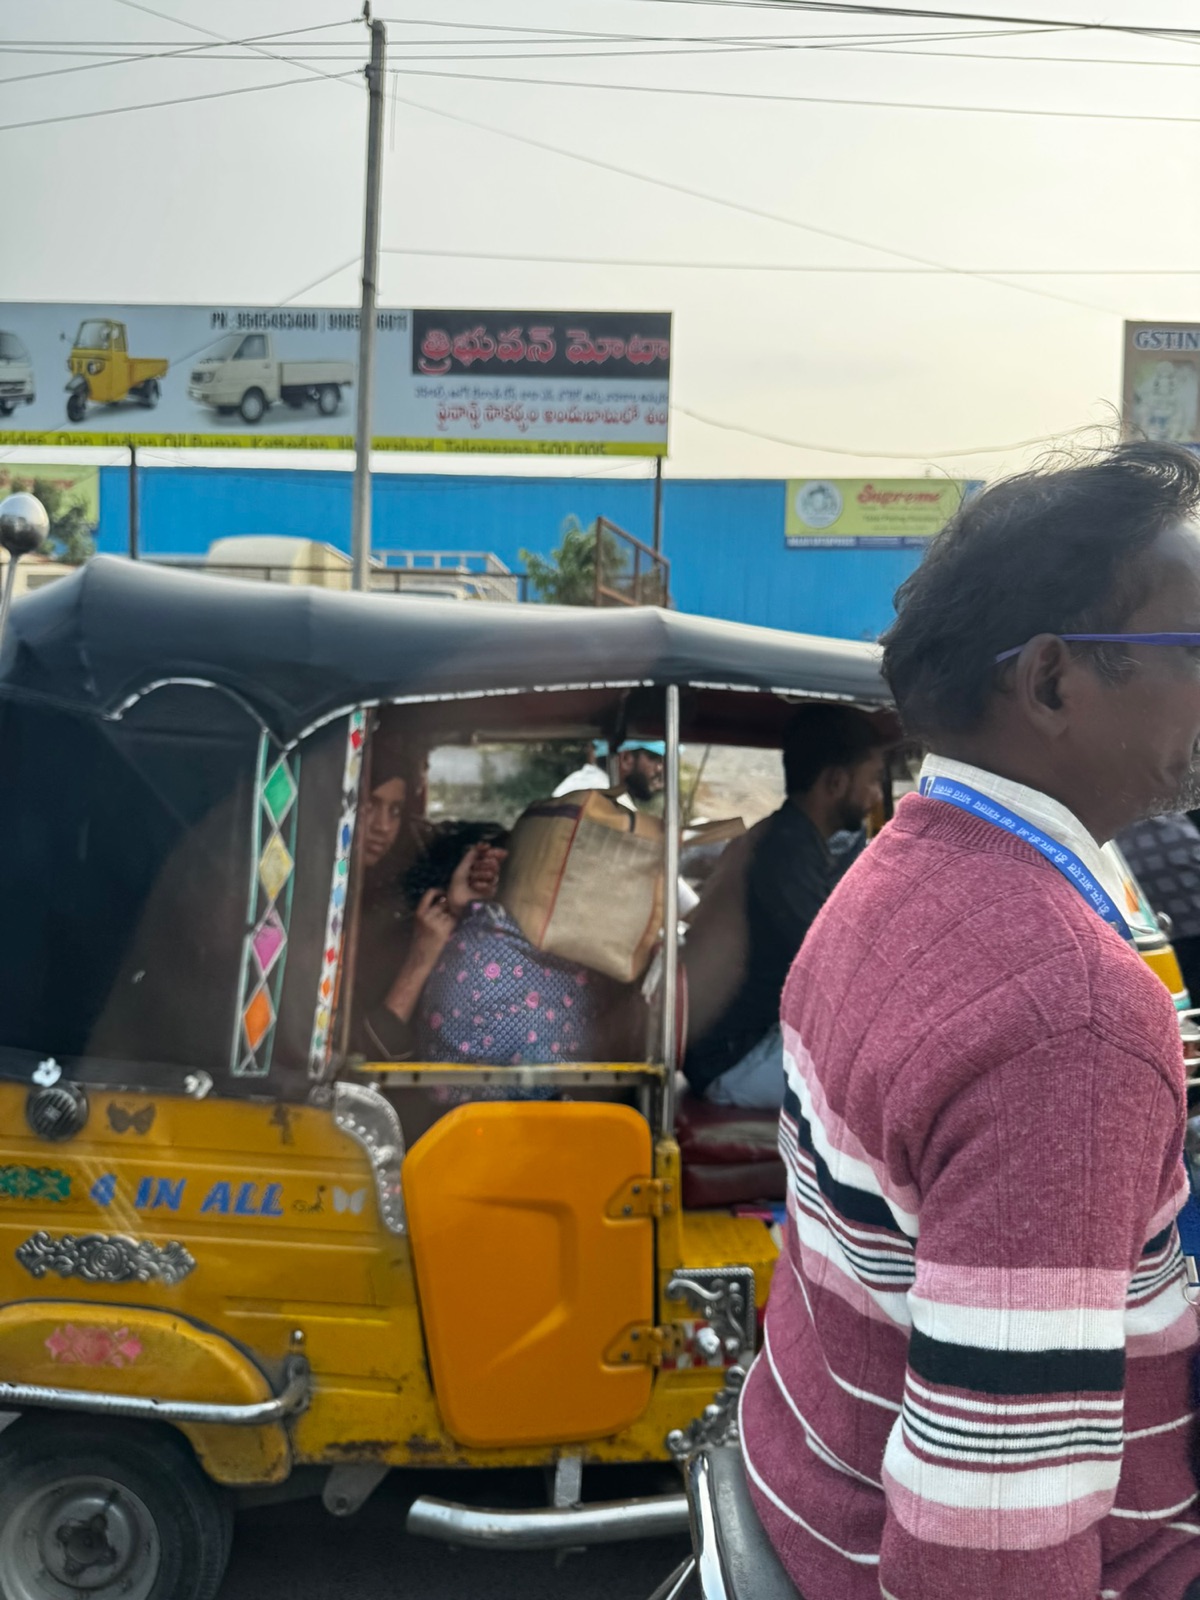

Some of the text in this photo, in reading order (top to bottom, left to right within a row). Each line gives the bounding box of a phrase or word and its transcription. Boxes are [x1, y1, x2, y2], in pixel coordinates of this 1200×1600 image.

[90, 1173, 284, 1217] 4 IN ALL
